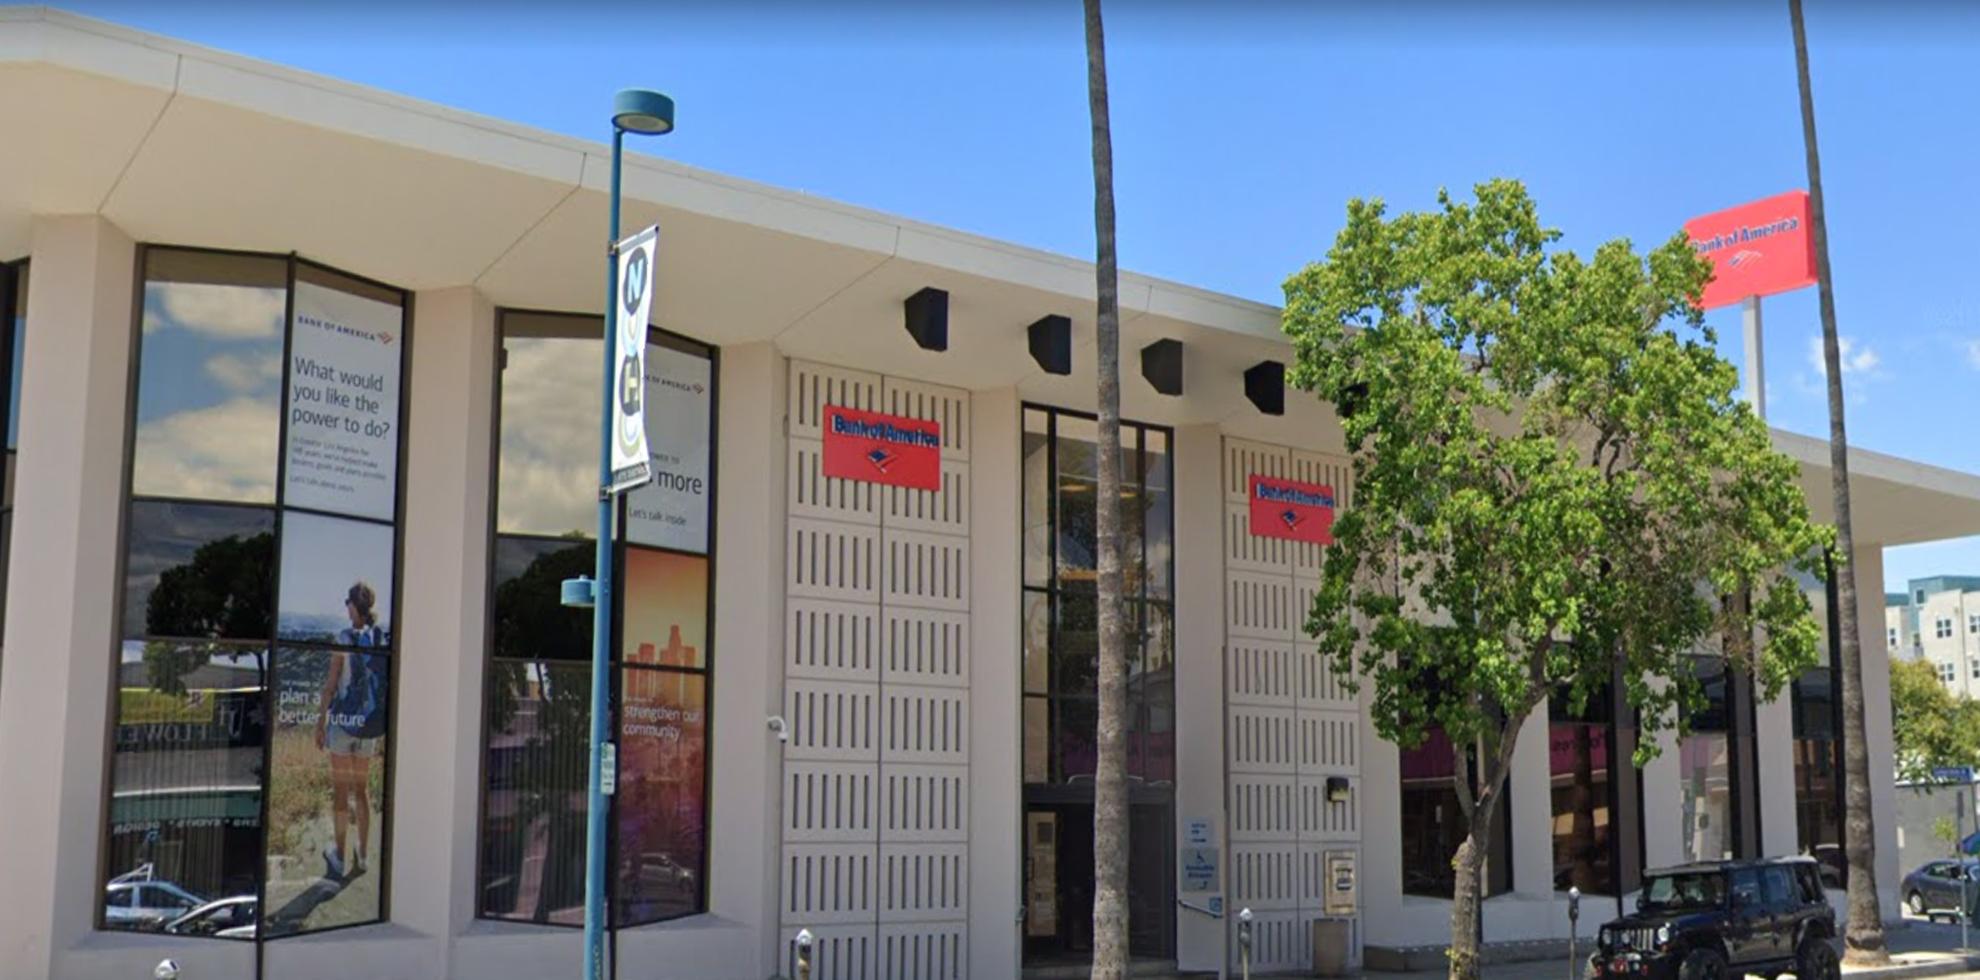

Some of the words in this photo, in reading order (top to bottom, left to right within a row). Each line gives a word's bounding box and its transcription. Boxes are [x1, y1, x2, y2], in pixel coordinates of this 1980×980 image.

[1724, 229, 1739, 247] of
[1740, 216, 1798, 242] America
[298, 315, 322, 328] BANK
[324, 322, 335, 331] OF
[336, 325, 375, 341] AMERICA
[295, 356, 334, 382] What
[340, 371, 384, 392] would
[293, 385, 320, 403] you
[326, 388, 350, 408] like
[355, 395, 380, 414] the
[292, 409, 340, 429] power
[344, 416, 360, 433] to
[365, 420, 390, 440] do?
[832, 413, 865, 438] Bank
[866, 422, 882, 439] of
[883, 425, 939, 448] America
[658, 470, 702, 495] more
[629, 506, 647, 519] Let's
[648, 509, 663, 522] talk
[279, 687, 308, 706] plan
[312, 692, 321, 704] a
[278, 707, 321, 724] better
[326, 709, 365, 727] future
[624, 705, 681, 722] strengthen
[683, 709, 700, 721] our
[623, 723, 681, 741] community
